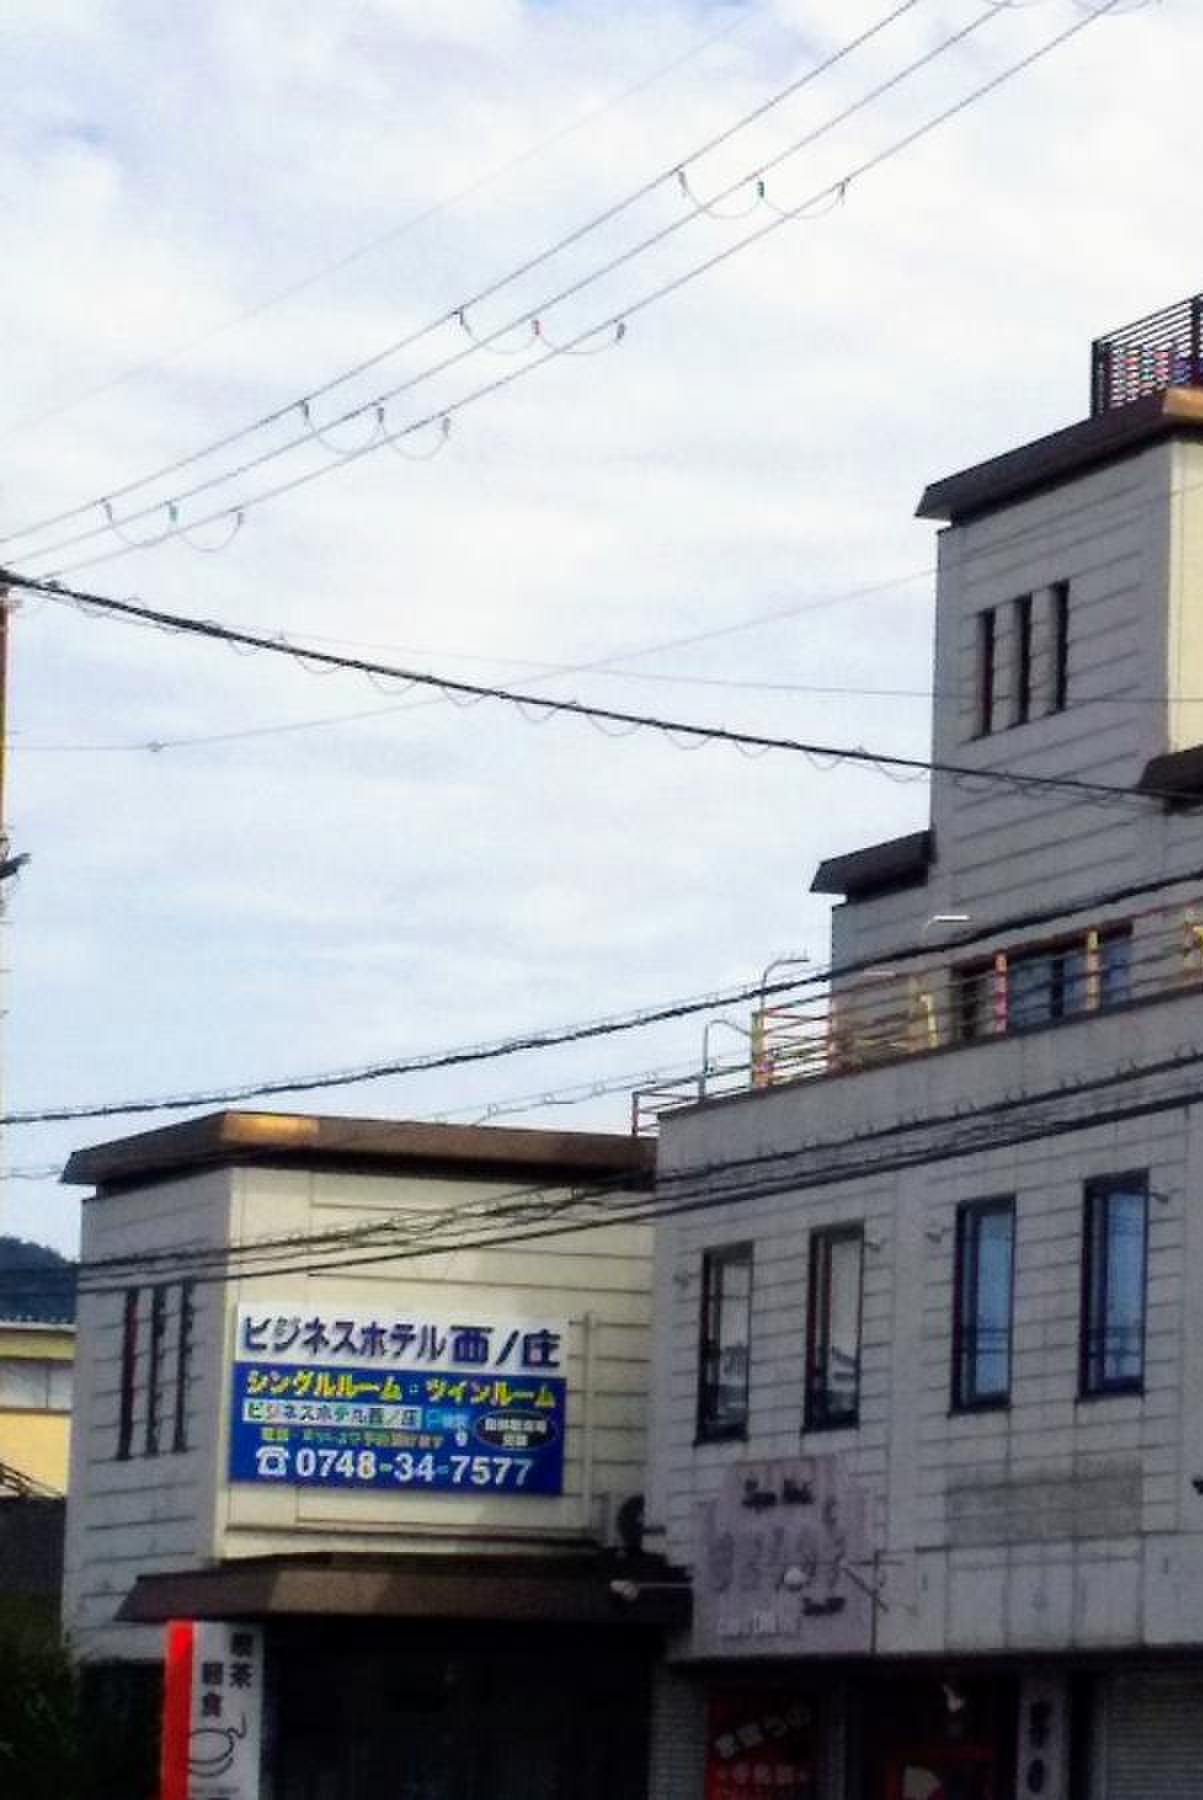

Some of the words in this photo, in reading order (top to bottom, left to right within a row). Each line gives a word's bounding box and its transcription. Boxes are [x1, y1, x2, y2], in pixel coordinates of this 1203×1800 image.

[244, 1316, 561, 1368] ビジネスホテル西ノ庄
[246, 1370, 402, 1401] シングルルーム
[425, 1379, 555, 1408] ツインルーム
[295, 1449, 533, 1486] 0748-34-7577
